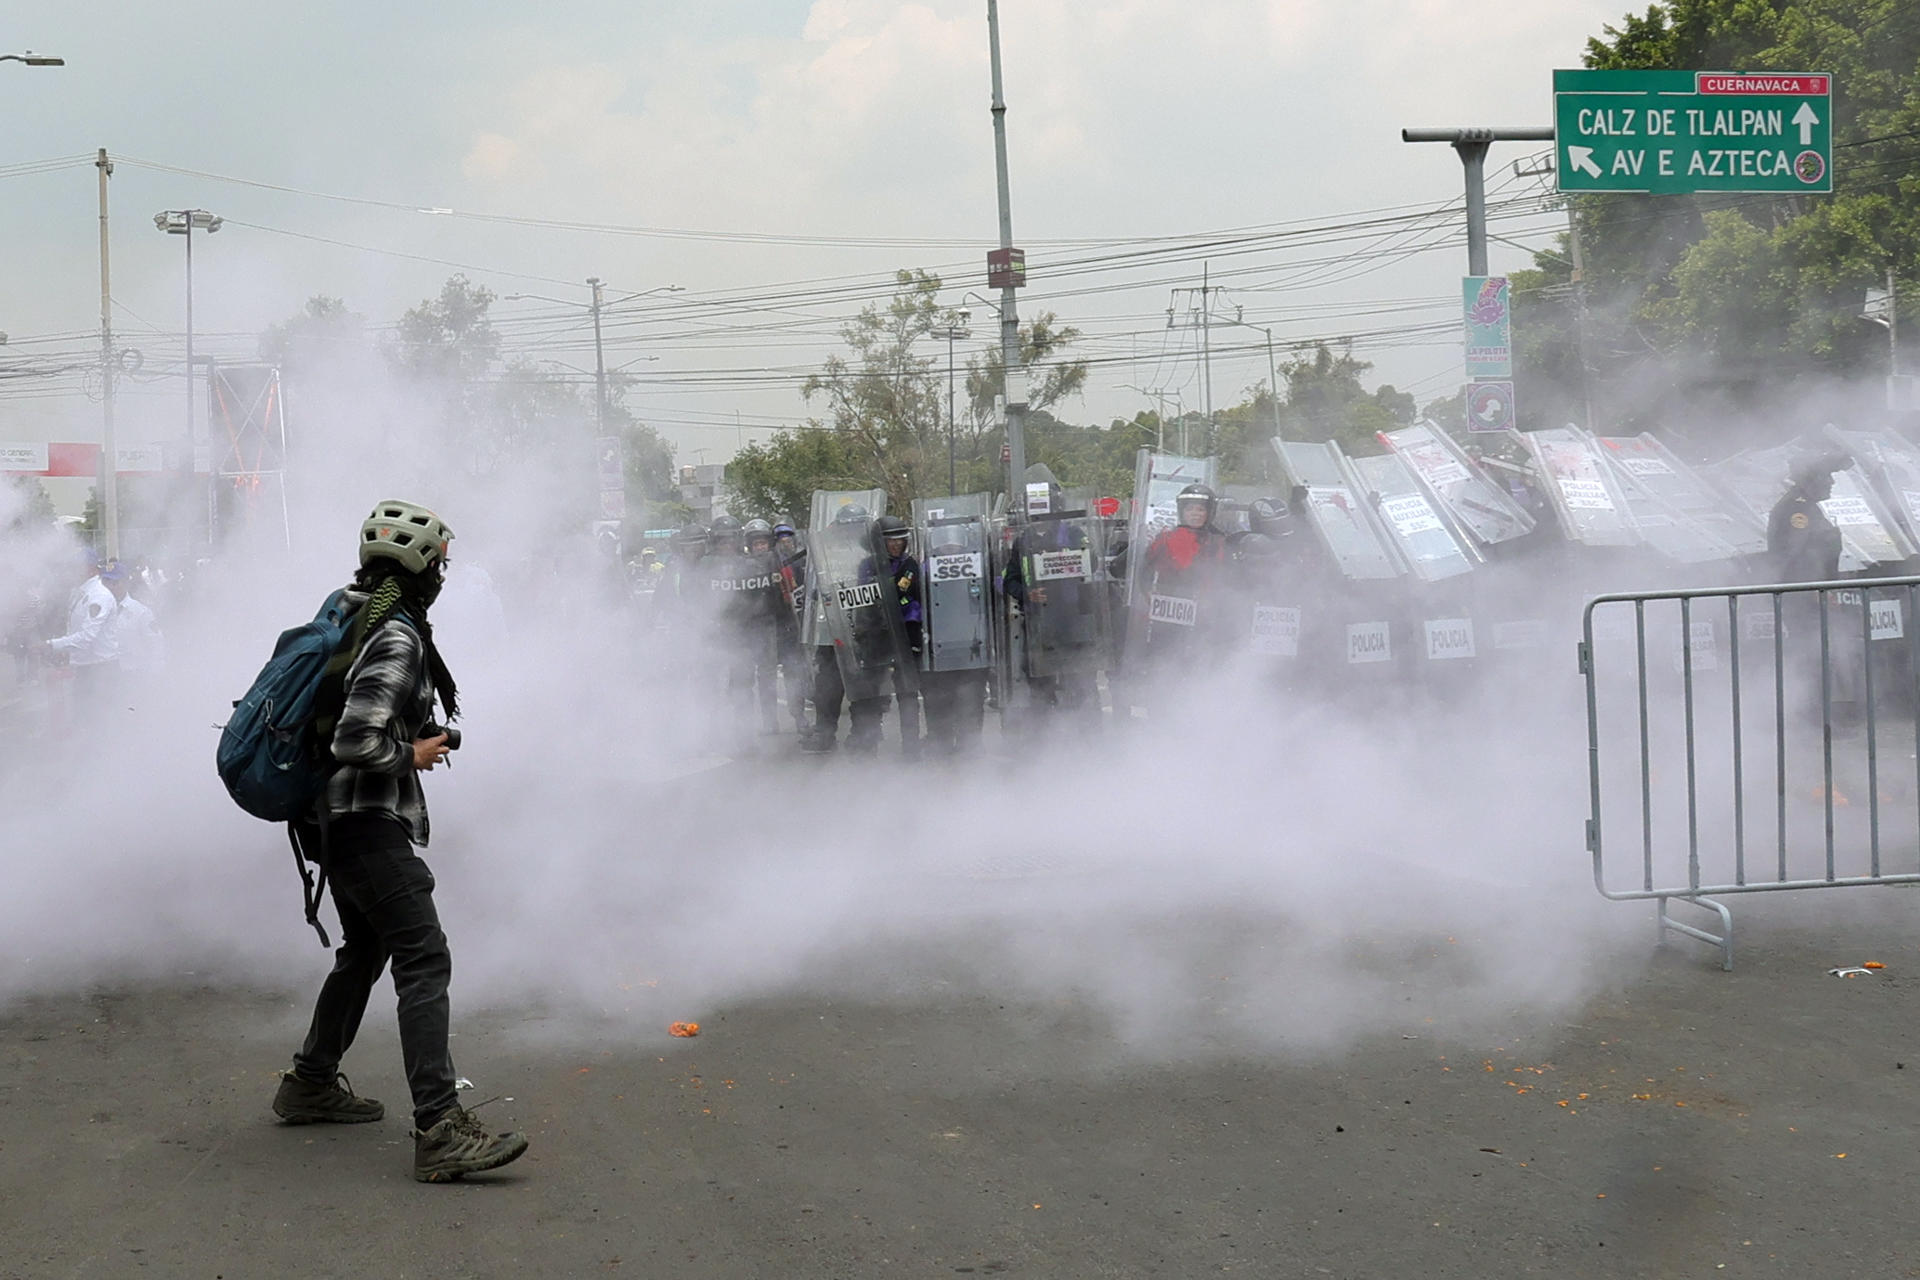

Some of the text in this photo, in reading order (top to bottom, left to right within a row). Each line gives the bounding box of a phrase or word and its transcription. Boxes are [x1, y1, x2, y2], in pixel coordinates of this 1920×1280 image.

[1707, 79, 1800, 91] CUERNAVACA
[1578, 108, 1783, 136] CALZ DE TLALPAN
[1611, 149, 1793, 176] AV E AZTECA
[1480, 347, 1507, 355] PELOTA
[1393, 508, 1431, 521] AUXILIAR
[936, 555, 972, 566] POLICÍA
[938, 564, 974, 579] SSC
[711, 576, 770, 591] POLICIA
[838, 585, 882, 608] POLICIA
[1152, 598, 1195, 622] POLICIA
[1351, 632, 1385, 653] POLICIA
[1431, 628, 1470, 649] POLICIA
